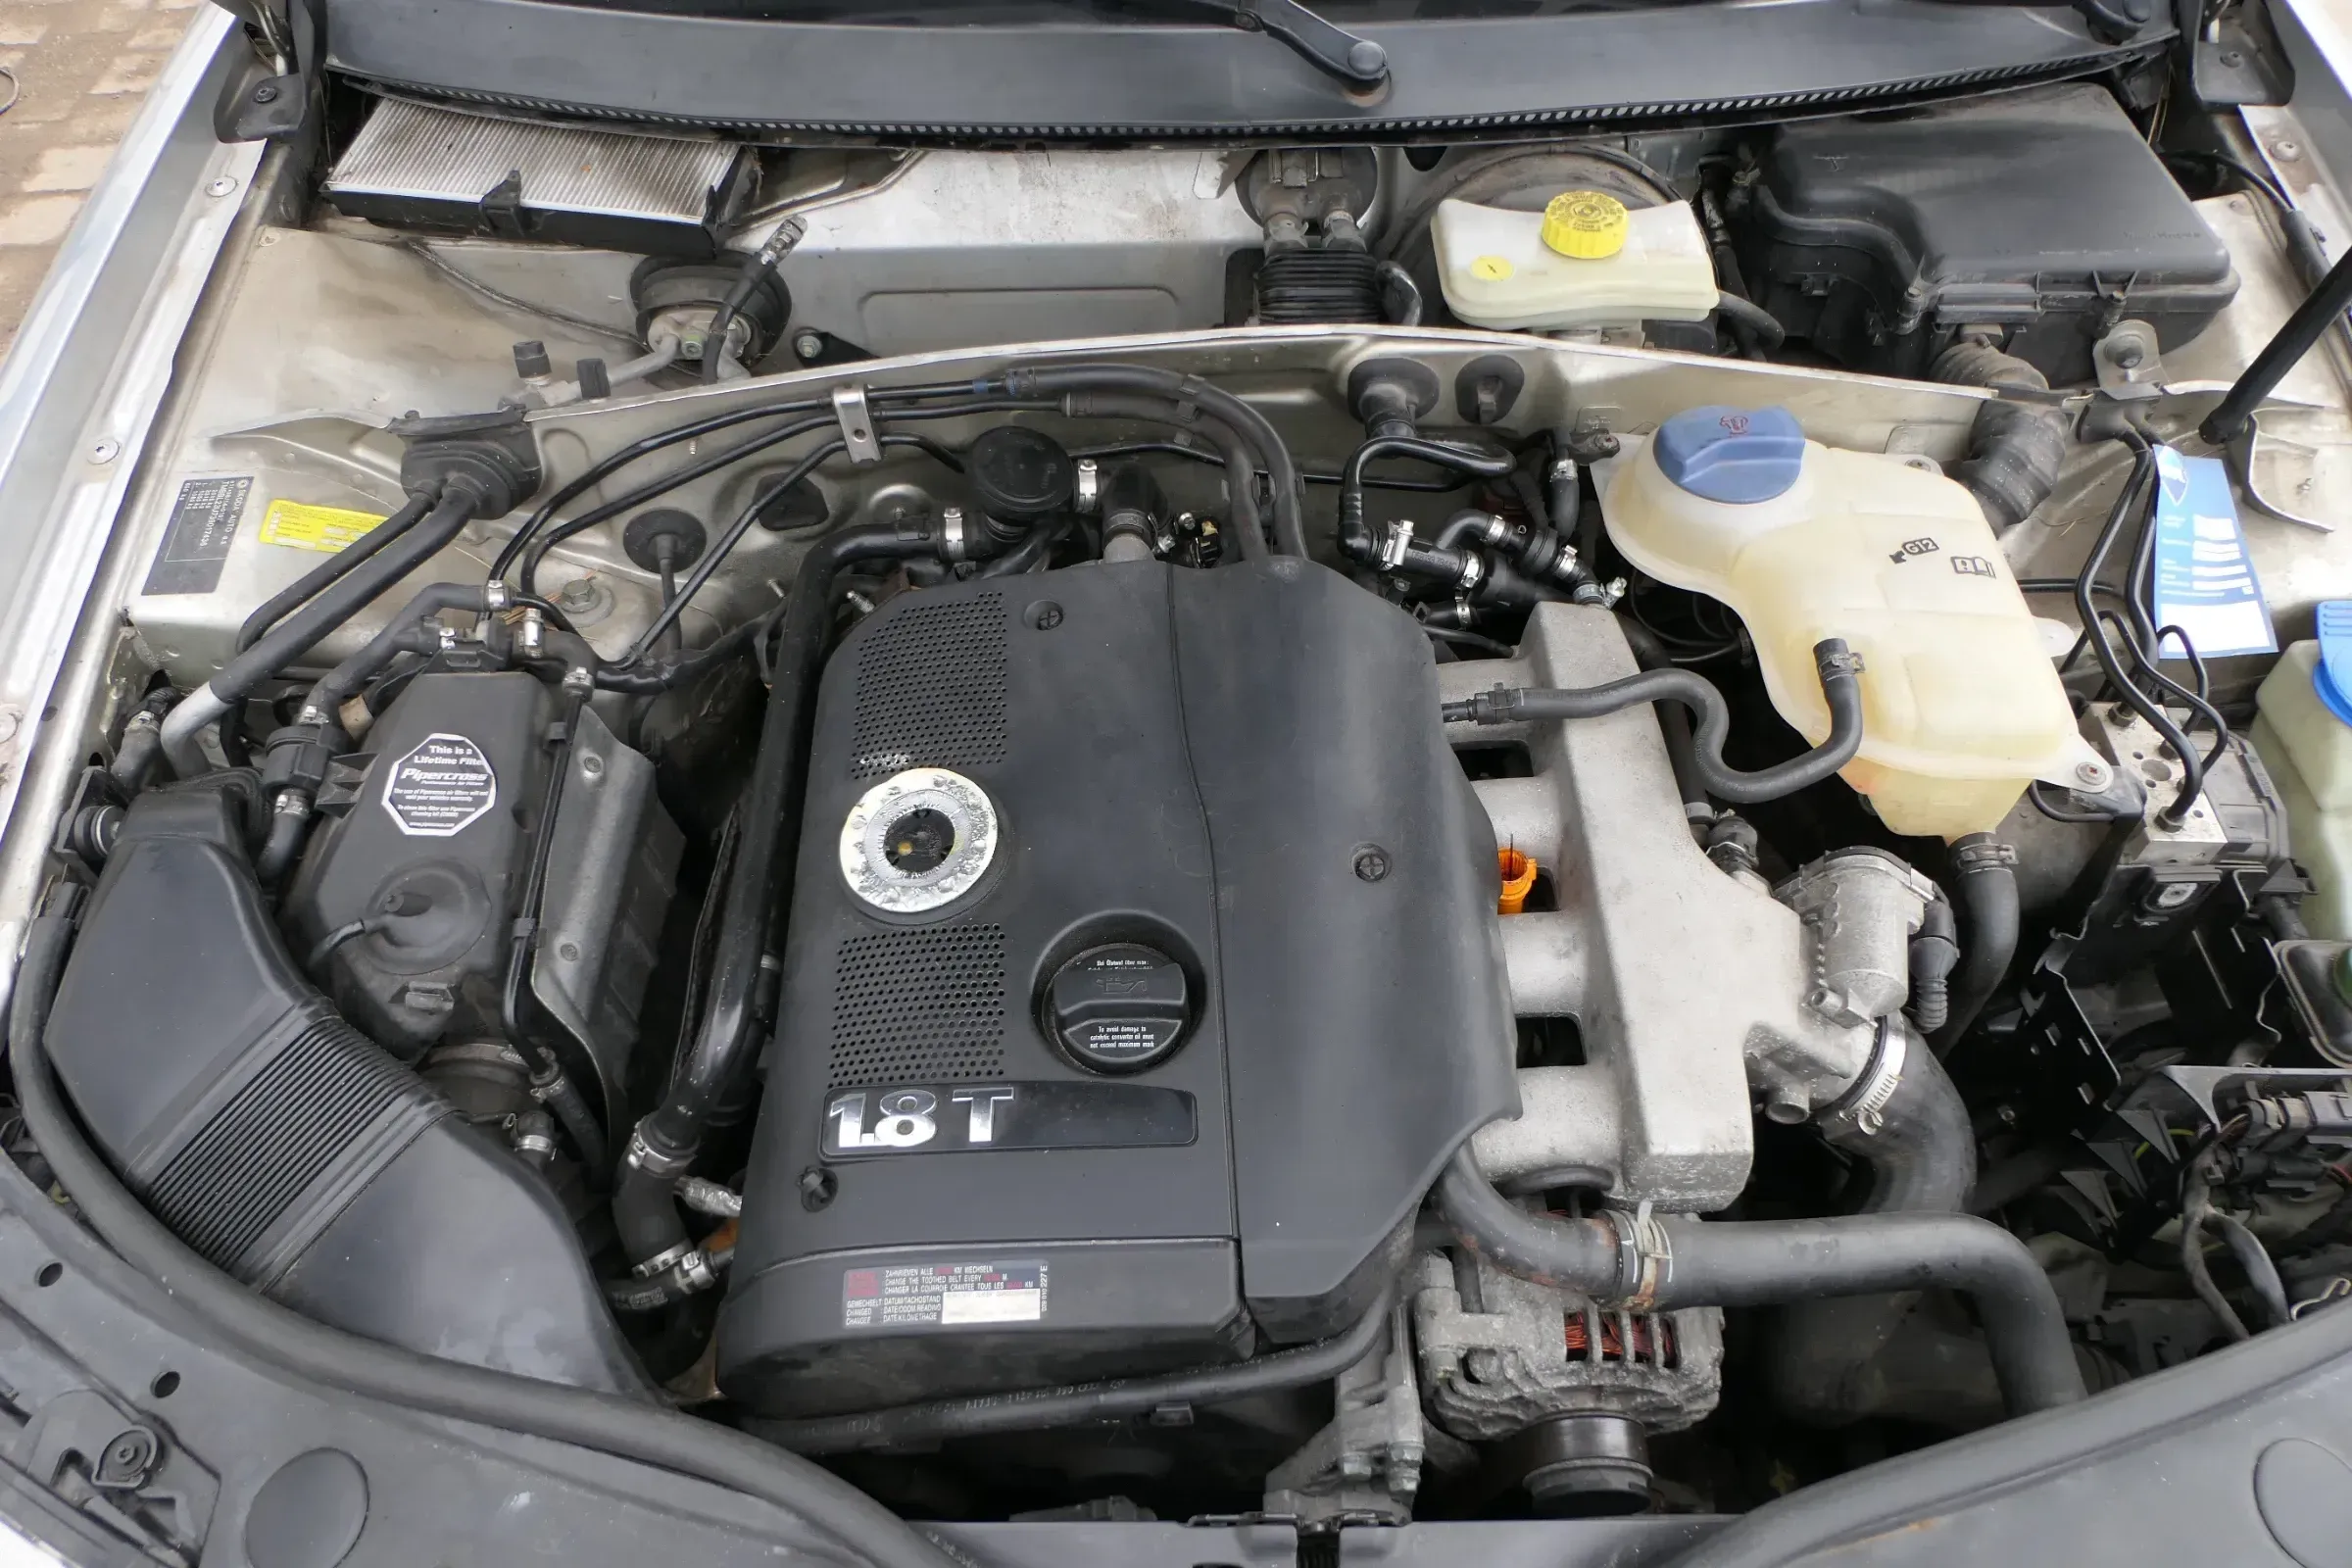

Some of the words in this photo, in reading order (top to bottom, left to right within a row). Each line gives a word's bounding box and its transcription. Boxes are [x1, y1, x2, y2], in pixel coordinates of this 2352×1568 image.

[225, 514, 237, 532] AUTO
[1905, 539, 1937, 554] G12
[428, 745, 453, 755] This
[455, 746, 465, 755] is
[414, 755, 458, 764] Lifetime
[459, 757, 484, 765] Filte
[400, 767, 489, 782] Pipercross
[829, 1089, 937, 1148] 1.8
[952, 1087, 1014, 1143] T
[885, 1268, 918, 1278] ZAHNRIEMEN
[920, 1267, 934, 1276] ALLE
[964, 1265, 994, 1274] WECHSELN
[885, 1277, 906, 1287] CHANGE
[908, 1276, 919, 1285] THE
[922, 1275, 947, 1284] TOOTHED
[884, 1285, 909, 1296] CHANGER
[911, 1285, 919, 1294] LA
[920, 1284, 949, 1293] COURROIE
[977, 1282, 992, 1291] TOUS
[994, 1281, 1004, 1290] LES
[846, 1307, 872, 1318] CHANGED
